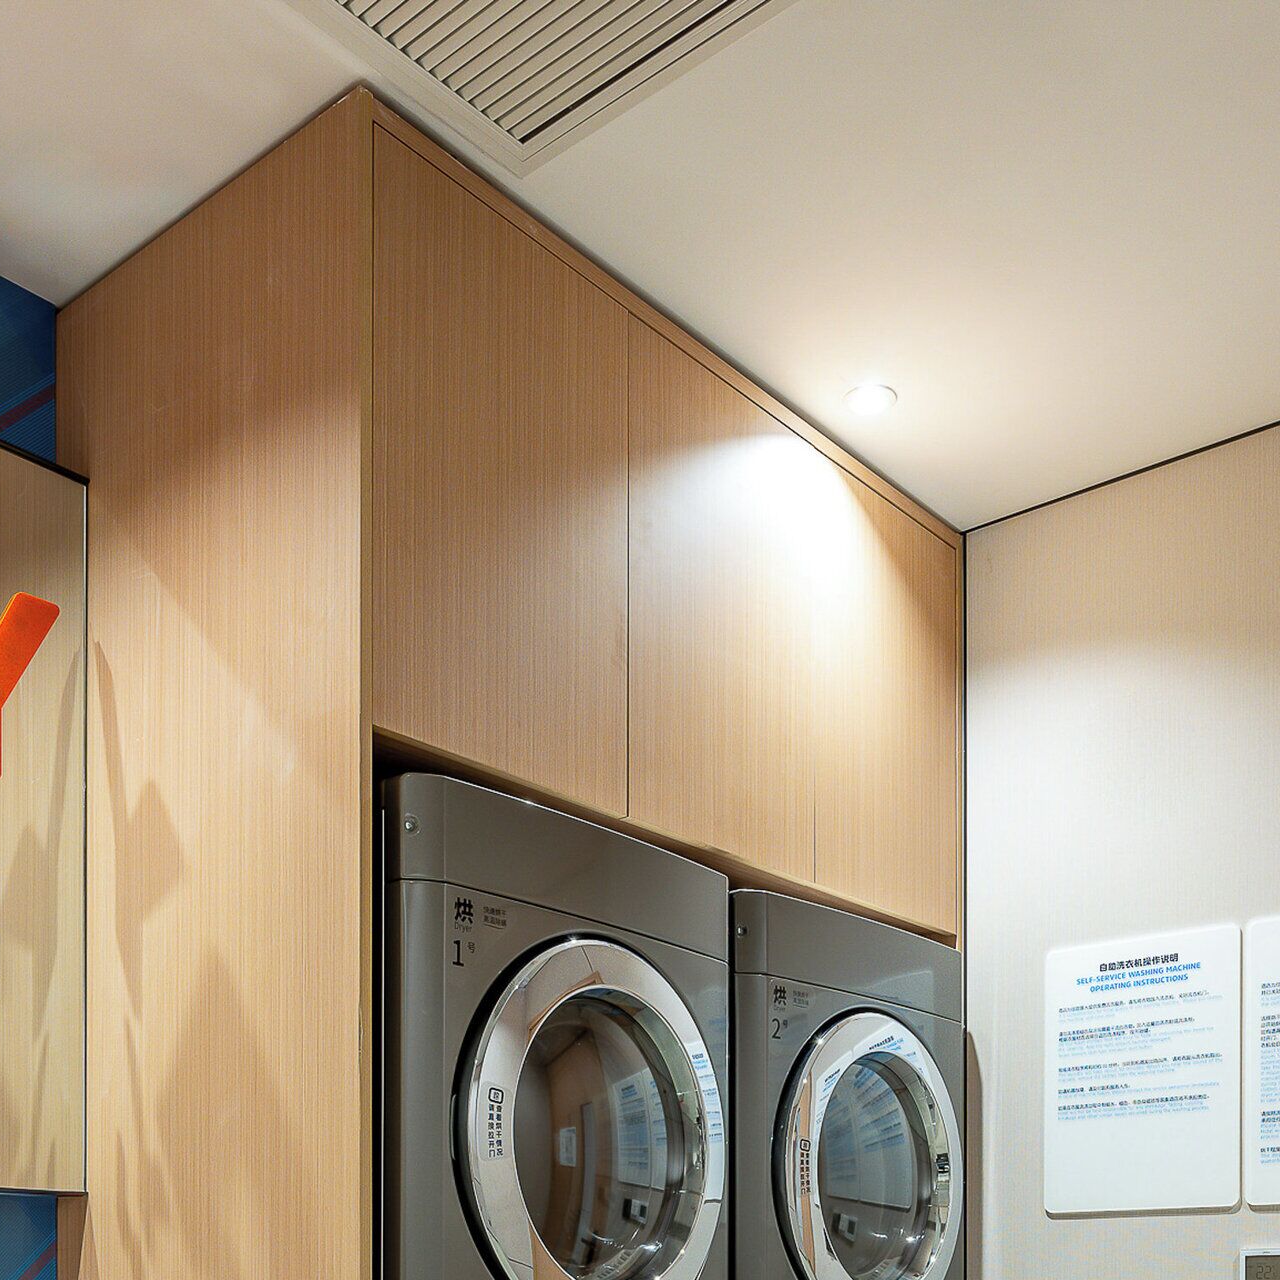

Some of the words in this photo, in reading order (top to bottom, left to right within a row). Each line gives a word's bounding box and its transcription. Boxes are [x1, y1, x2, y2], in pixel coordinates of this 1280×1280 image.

[454, 897, 473, 923] 烘
[454, 921, 473, 933] Dryer
[1099, 953, 1179, 972] 自助洗衣机操作说明
[1076, 972, 1127, 986] SELF-SERVICE
[1128, 967, 1164, 979] WASHING
[1166, 962, 1201, 973] MACHINE
[1090, 981, 1132, 993] OPERATING
[1133, 973, 1189, 987] INSTRUCTIONS
[773, 985, 787, 1006] 烘
